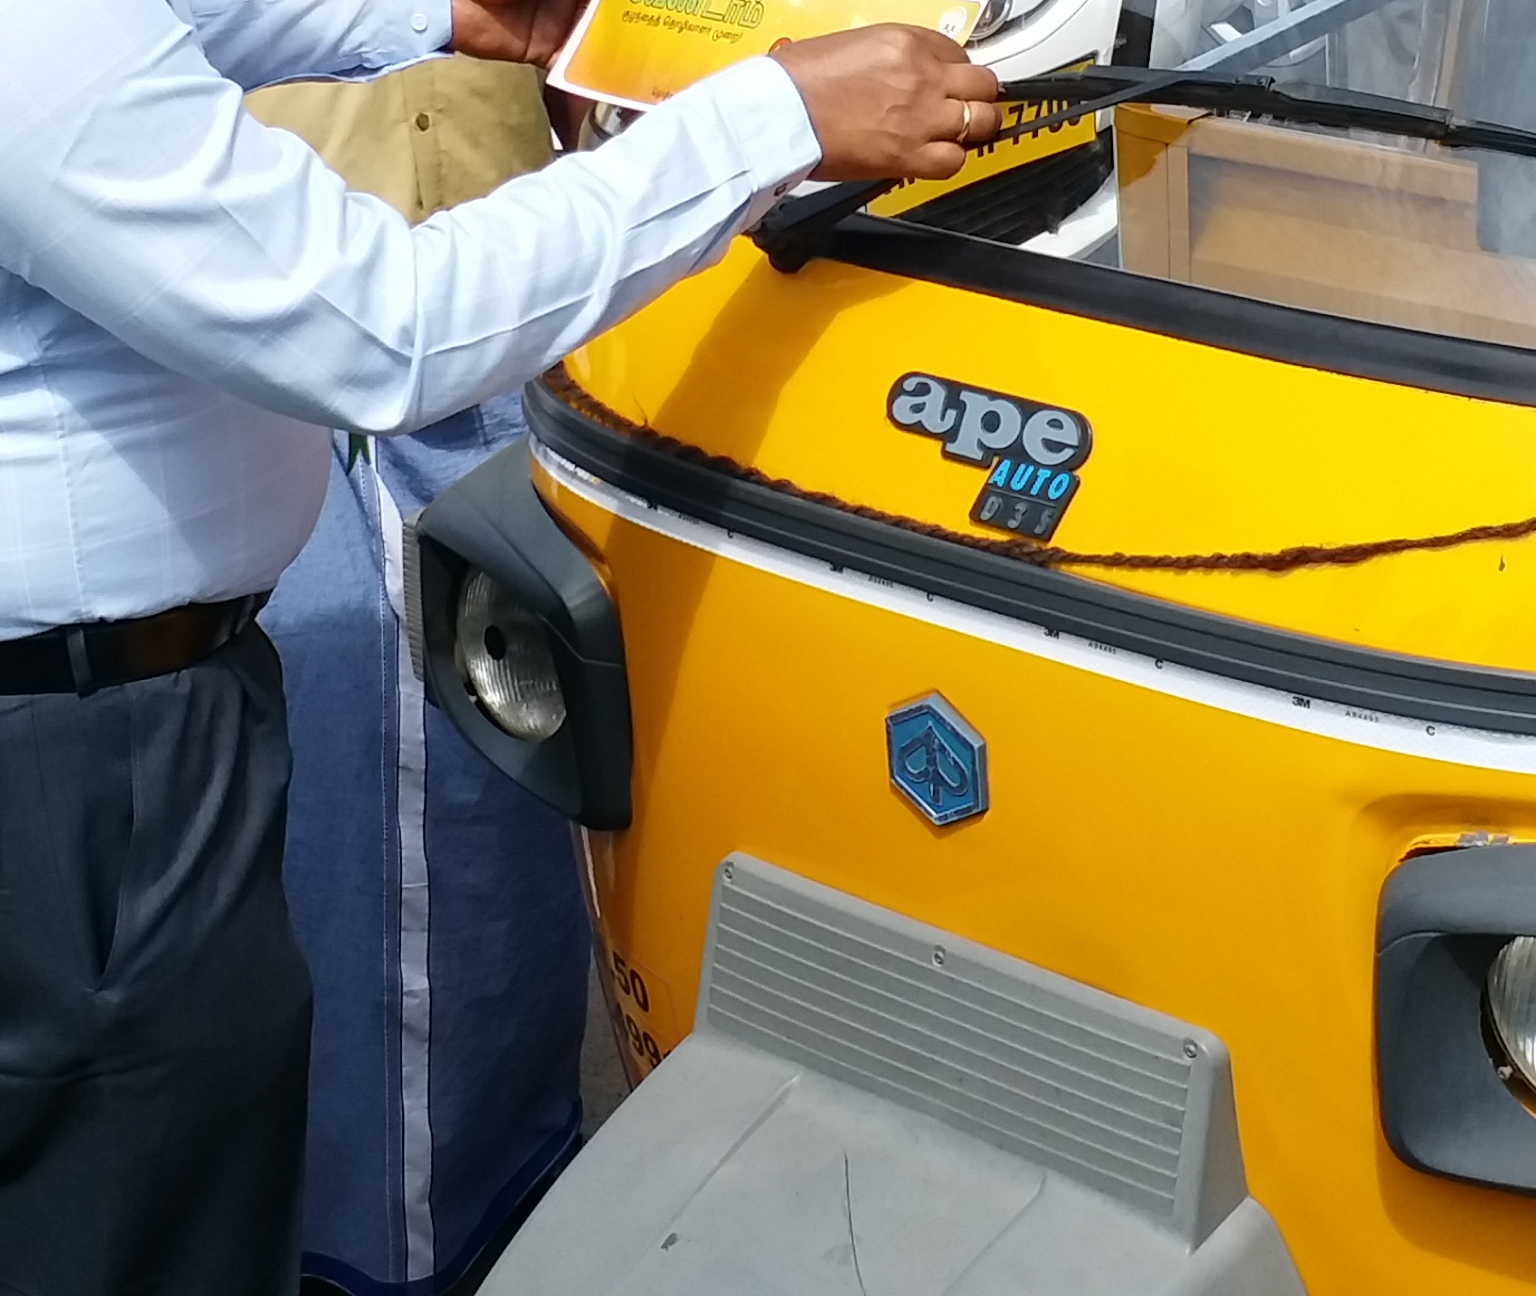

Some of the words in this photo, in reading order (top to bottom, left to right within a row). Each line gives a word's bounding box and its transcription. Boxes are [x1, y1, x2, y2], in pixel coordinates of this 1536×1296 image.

[892, 376, 1079, 465] ape
[988, 459, 1072, 500] AUTO
[1154, 657, 1164, 670] C
[1292, 695, 1311, 709] 3M
[1425, 724, 1436, 737] C
